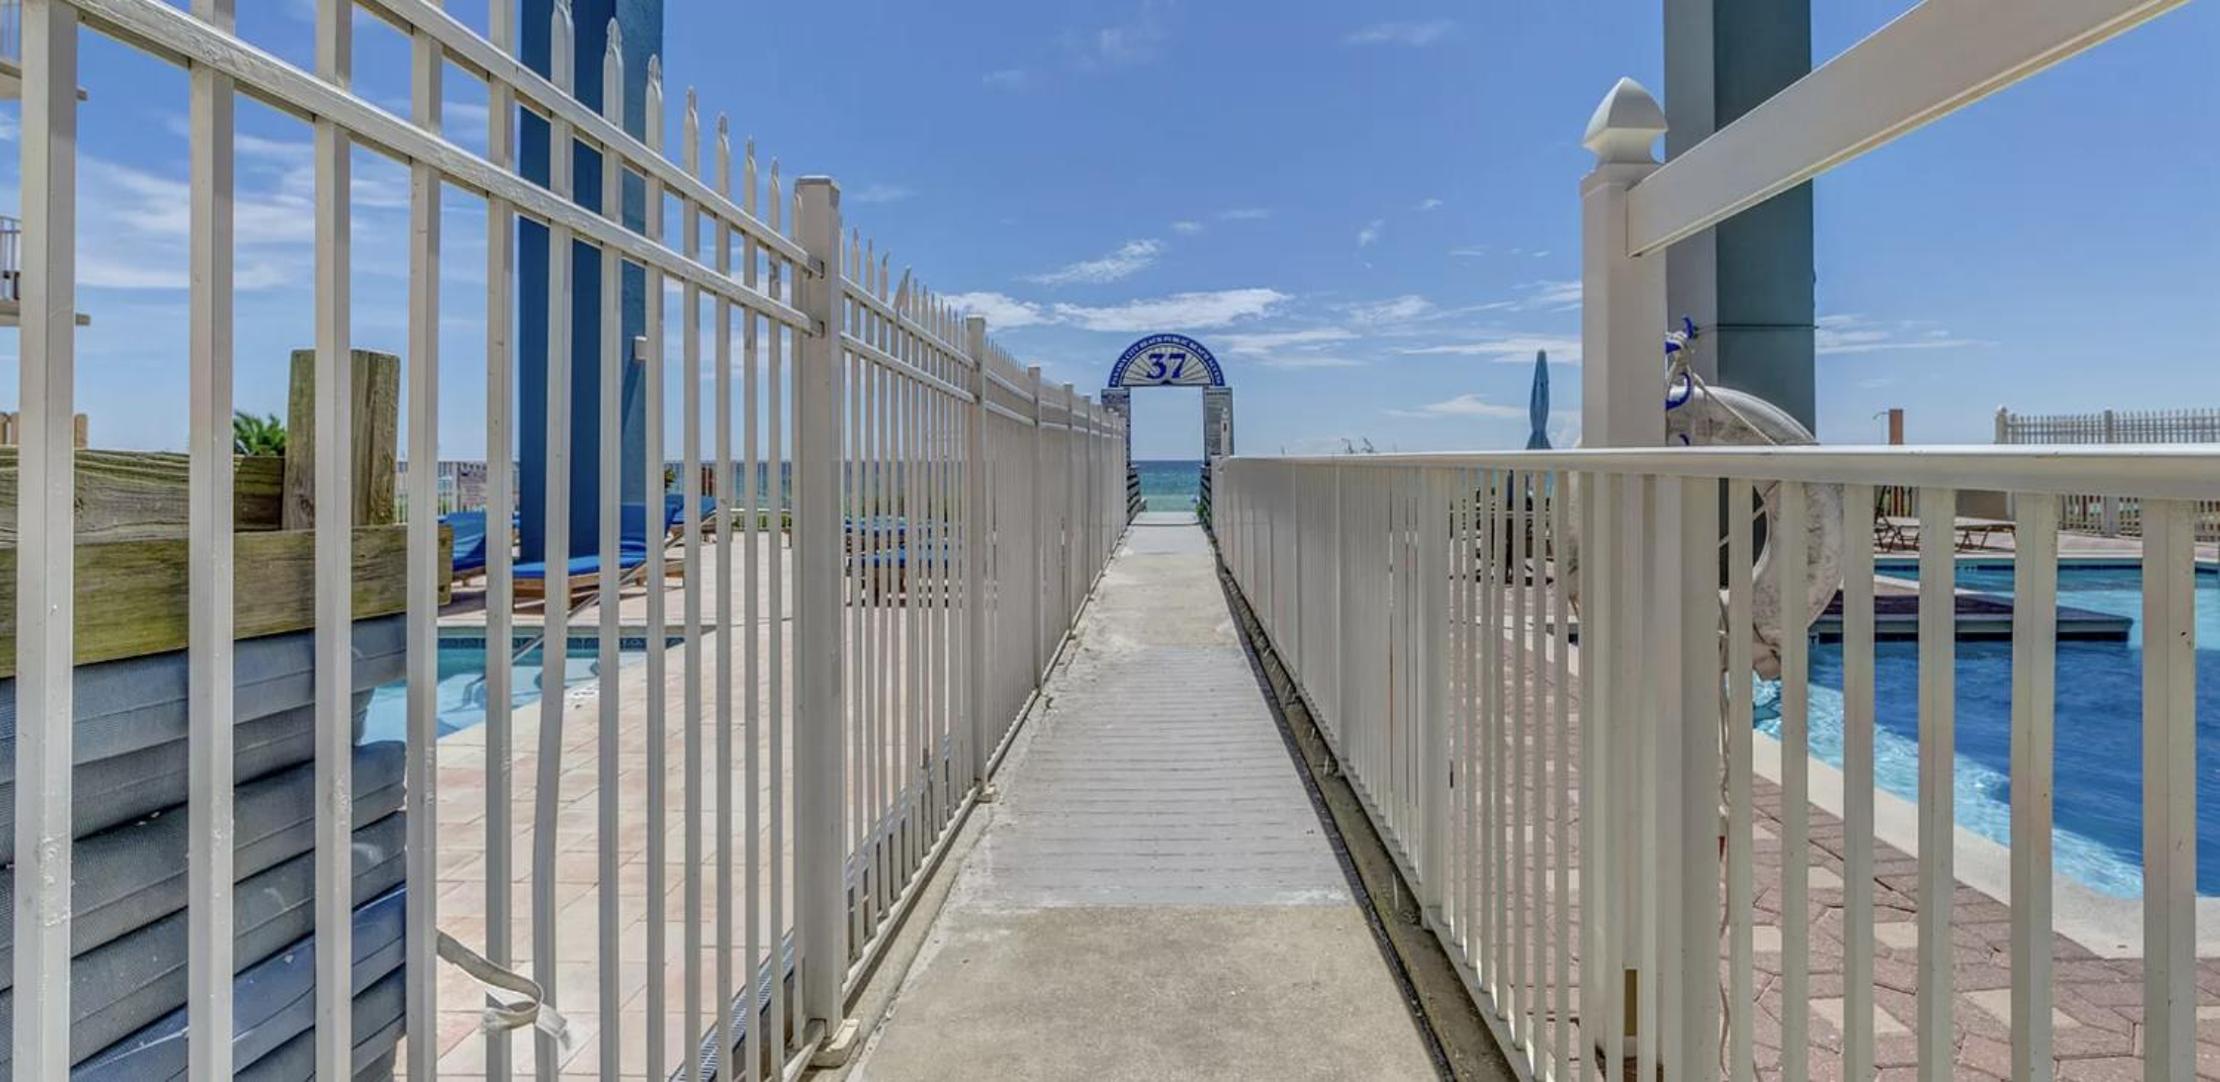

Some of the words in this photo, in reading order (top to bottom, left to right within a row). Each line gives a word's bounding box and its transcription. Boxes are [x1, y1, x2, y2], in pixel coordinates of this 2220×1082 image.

[1111, 359, 1127, 385] PANAMA
[1125, 346, 1139, 360] CITY
[1140, 336, 1162, 349] BEACH
[1163, 335, 1188, 345] PUBLIC
[1189, 342, 1210, 360] BEACH
[1146, 352, 1187, 379] 37
